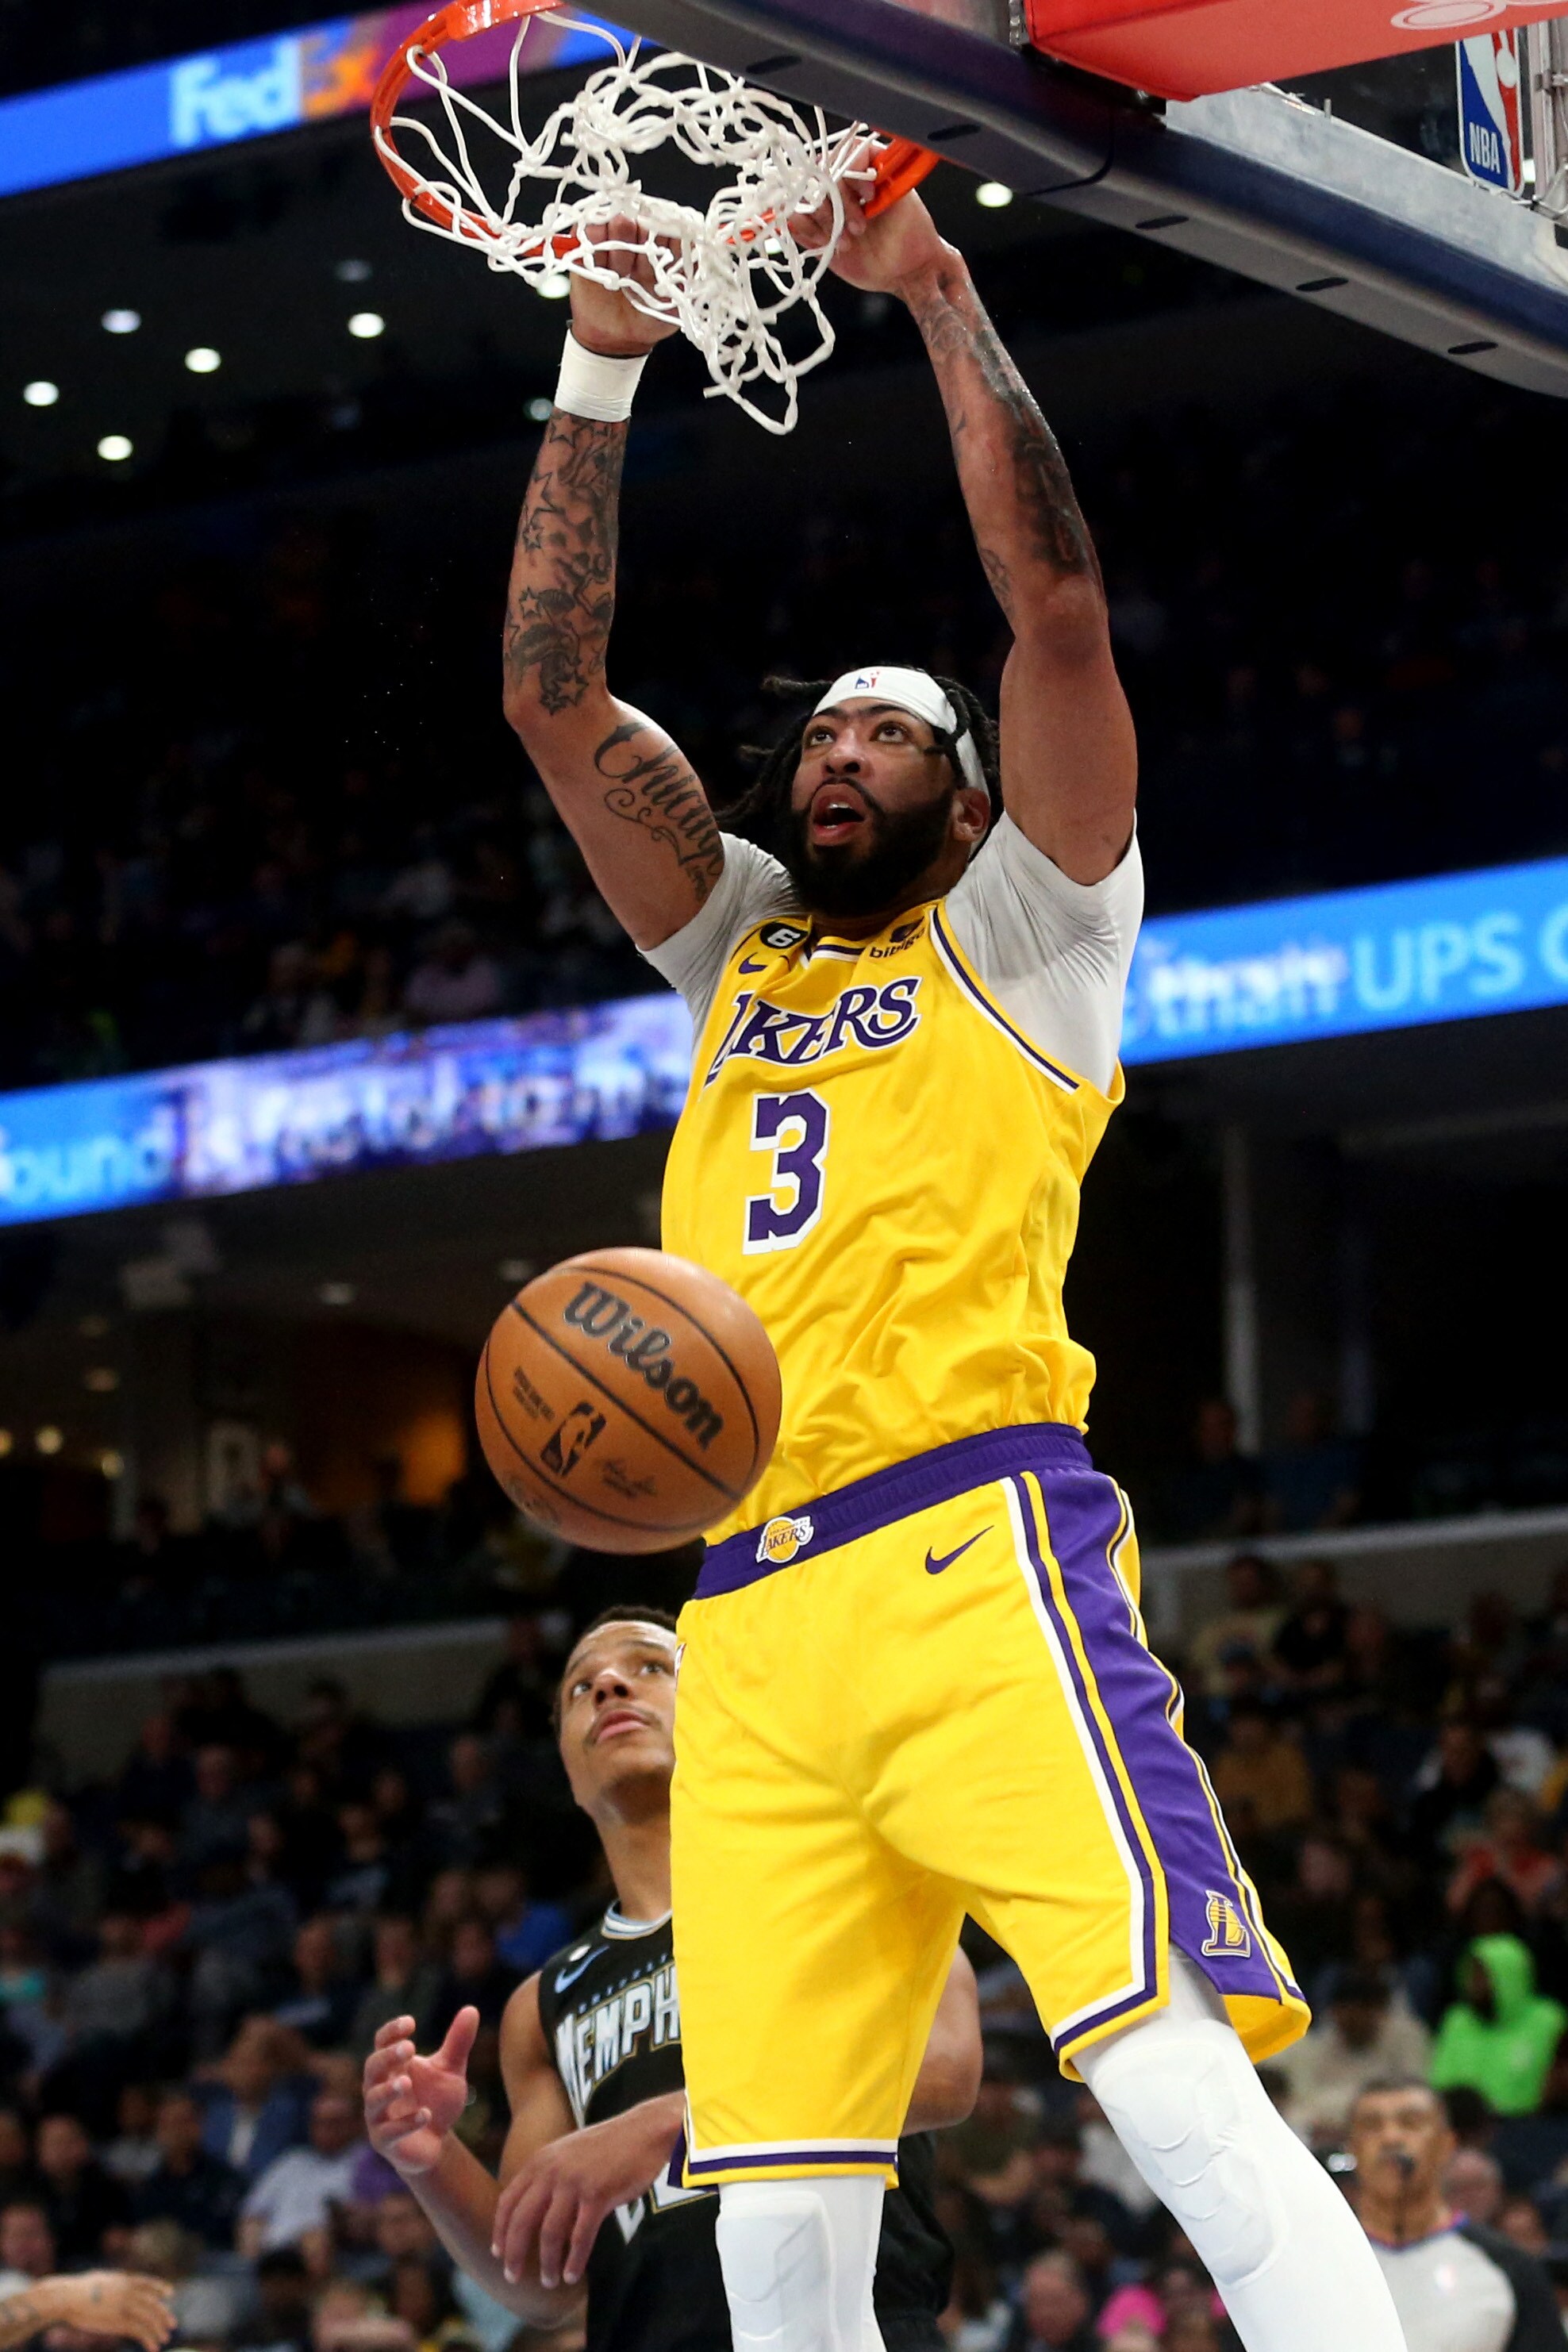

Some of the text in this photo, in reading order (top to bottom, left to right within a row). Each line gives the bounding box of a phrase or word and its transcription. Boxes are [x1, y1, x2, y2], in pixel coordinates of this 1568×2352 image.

[168, 32, 381, 148] FedEx
[1469, 121, 1501, 175] NBA
[767, 928, 801, 947] 6
[1353, 908, 1525, 1012] UPS
[703, 976, 923, 1090] LKERS
[743, 1087, 830, 1255] 3
[563, 1280, 725, 1451] Wilson
